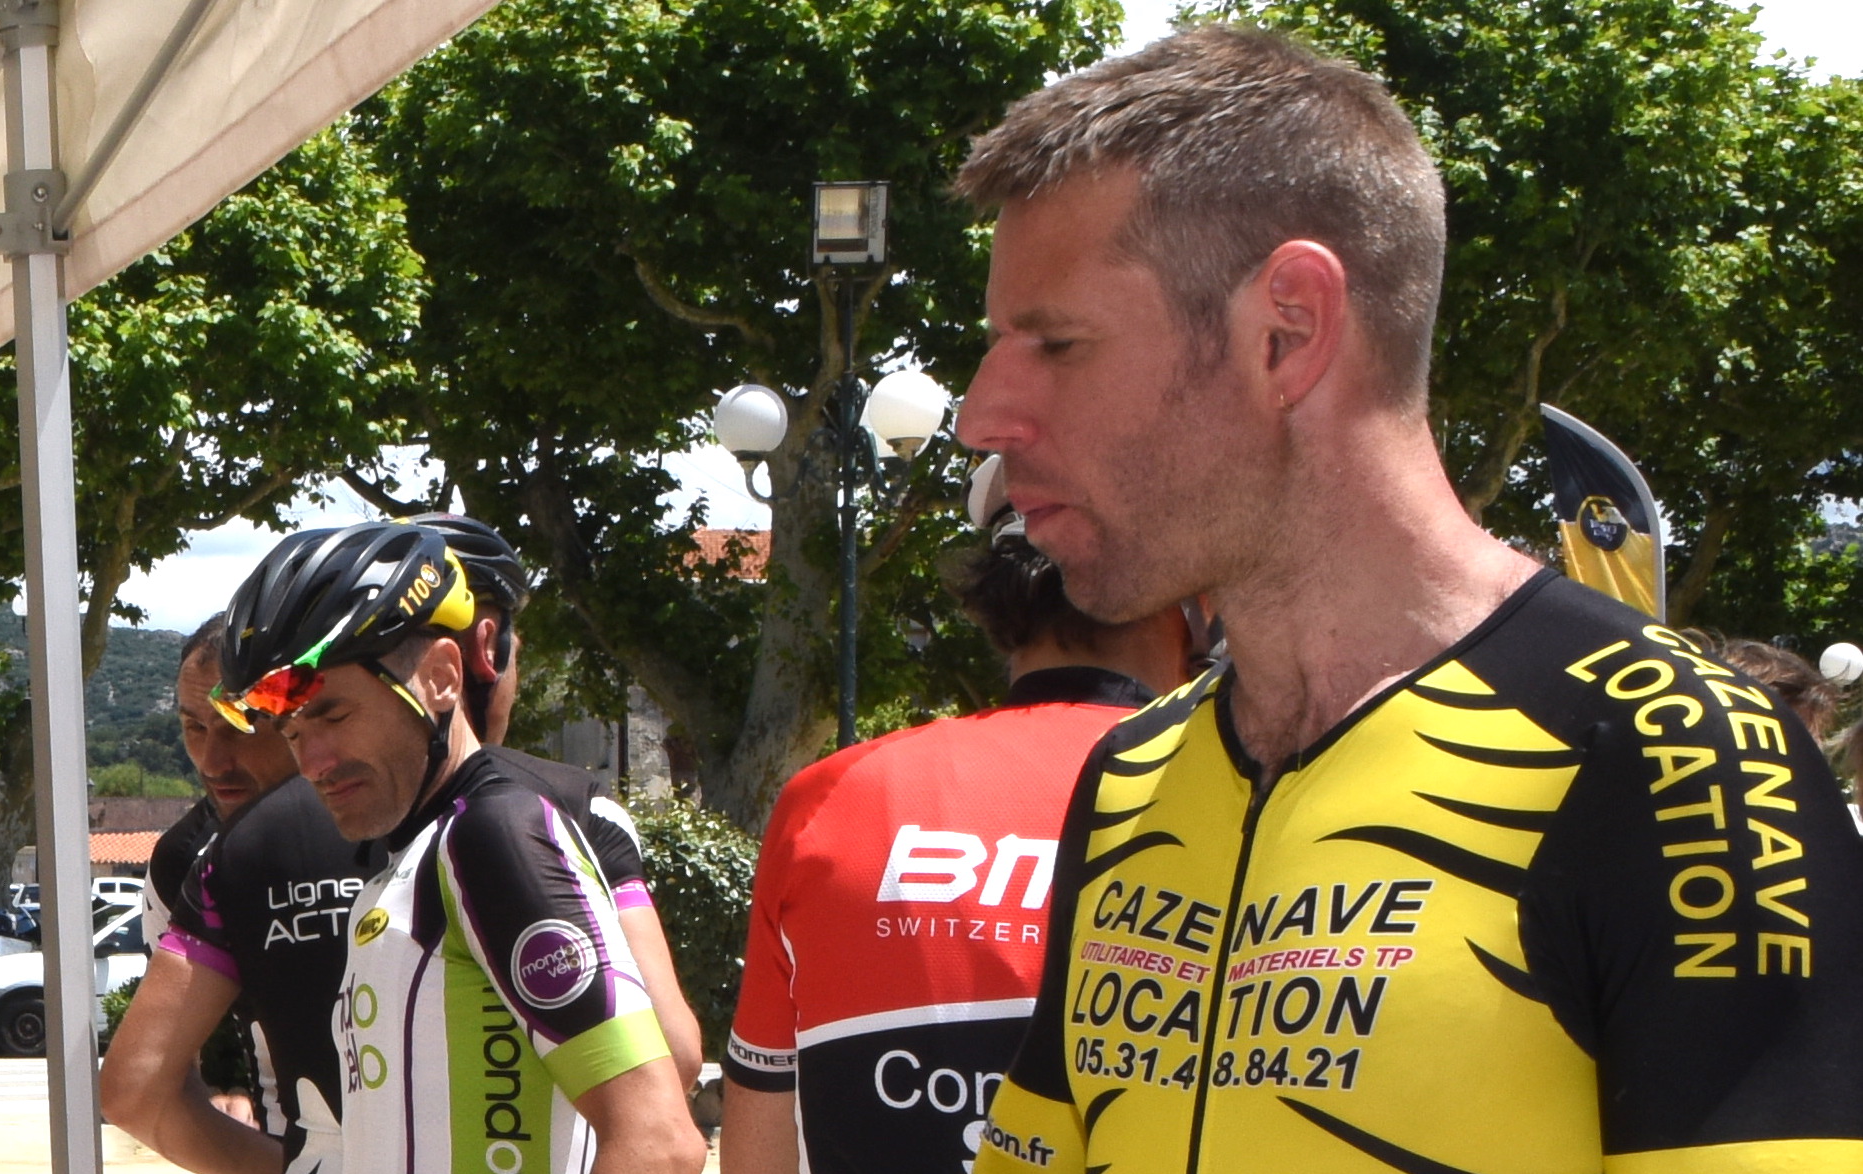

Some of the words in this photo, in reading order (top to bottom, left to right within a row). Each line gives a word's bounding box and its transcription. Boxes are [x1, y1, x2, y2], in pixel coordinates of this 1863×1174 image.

[268, 877, 364, 910] Ligne
[1564, 640, 1738, 979] LOCATION
[1642, 624, 1811, 979] CAZENAVE
[1080, 940, 1174, 975] UTILITAIRES
[1175, 962, 1211, 984] ET
[1226, 947, 1365, 983] MATERIELS
[1374, 947, 1414, 969] TP
